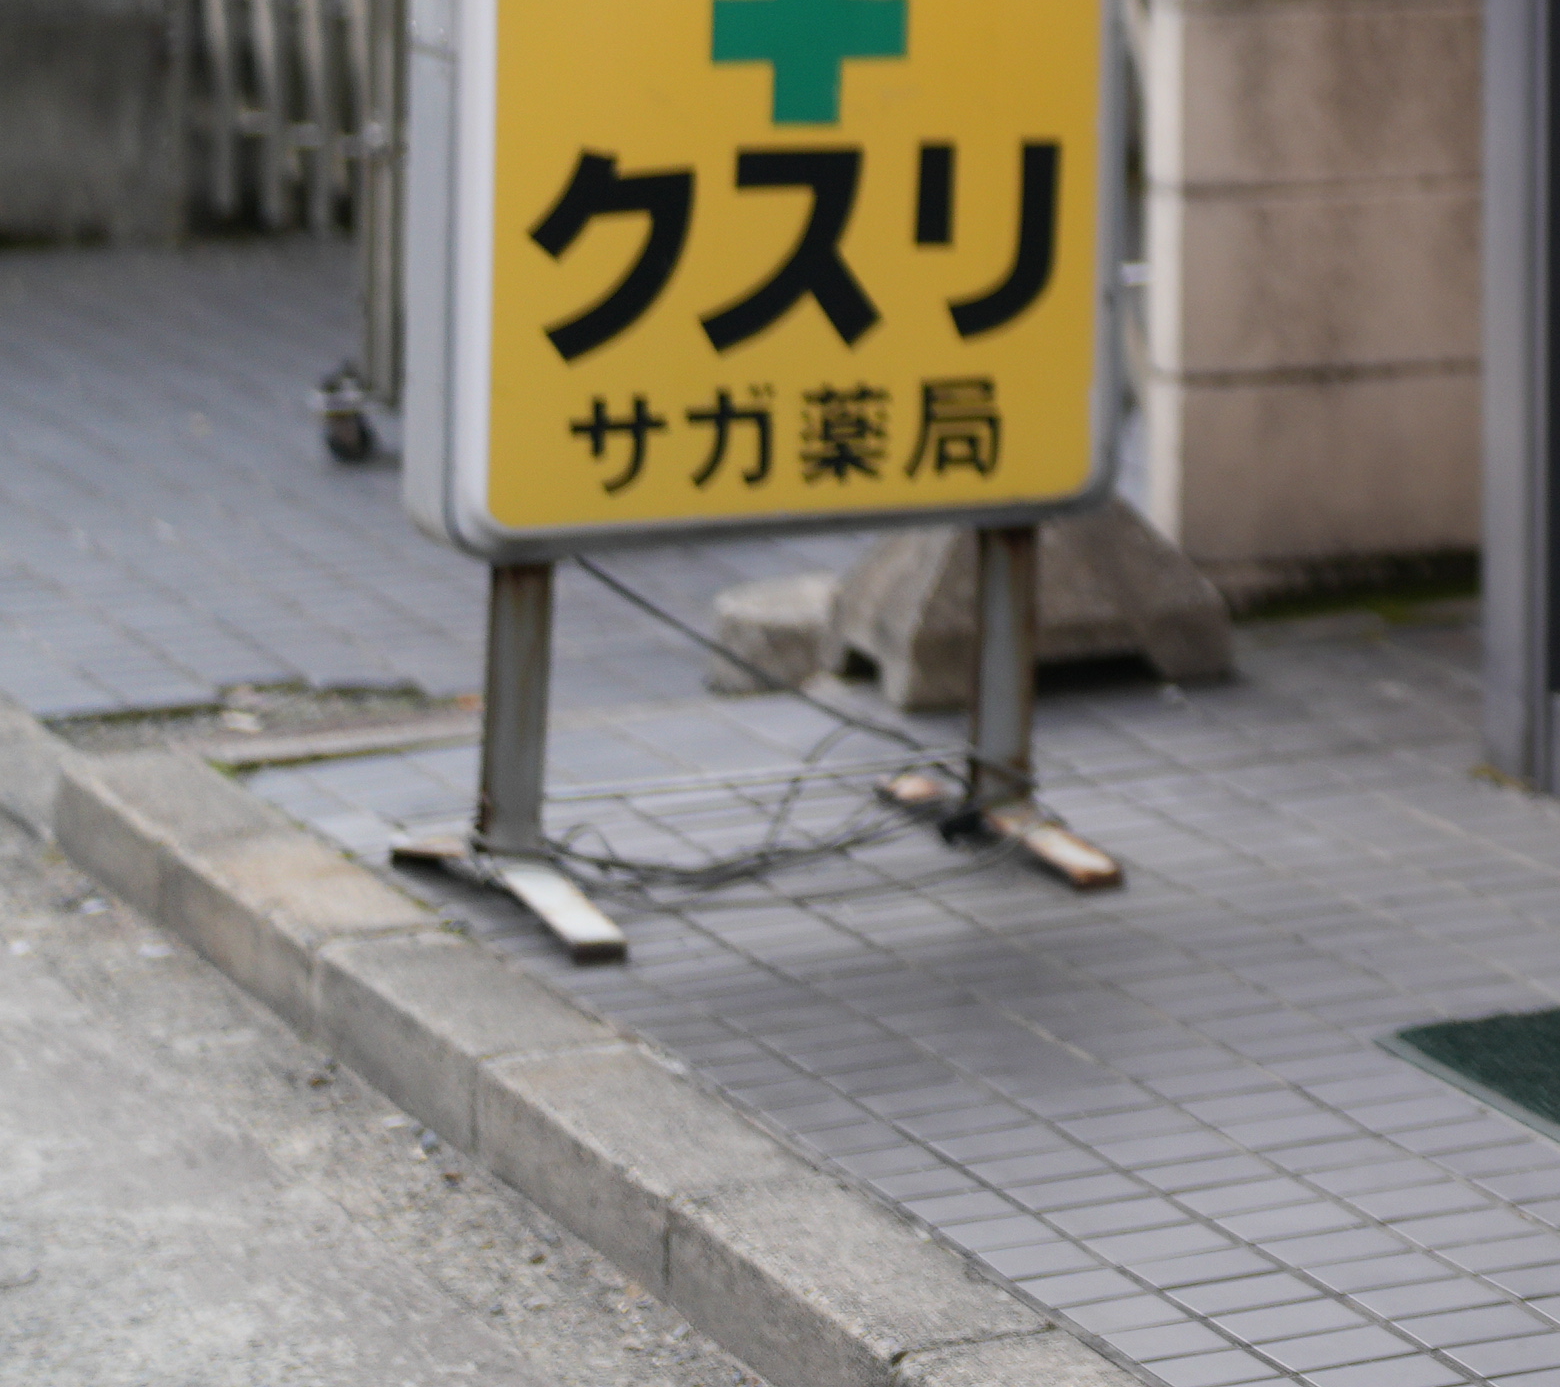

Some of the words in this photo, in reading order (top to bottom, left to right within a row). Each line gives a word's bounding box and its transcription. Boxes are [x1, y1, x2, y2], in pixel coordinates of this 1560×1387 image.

[527, 139, 1062, 362] クスリ
[569, 378, 1003, 496] サガ薬局
